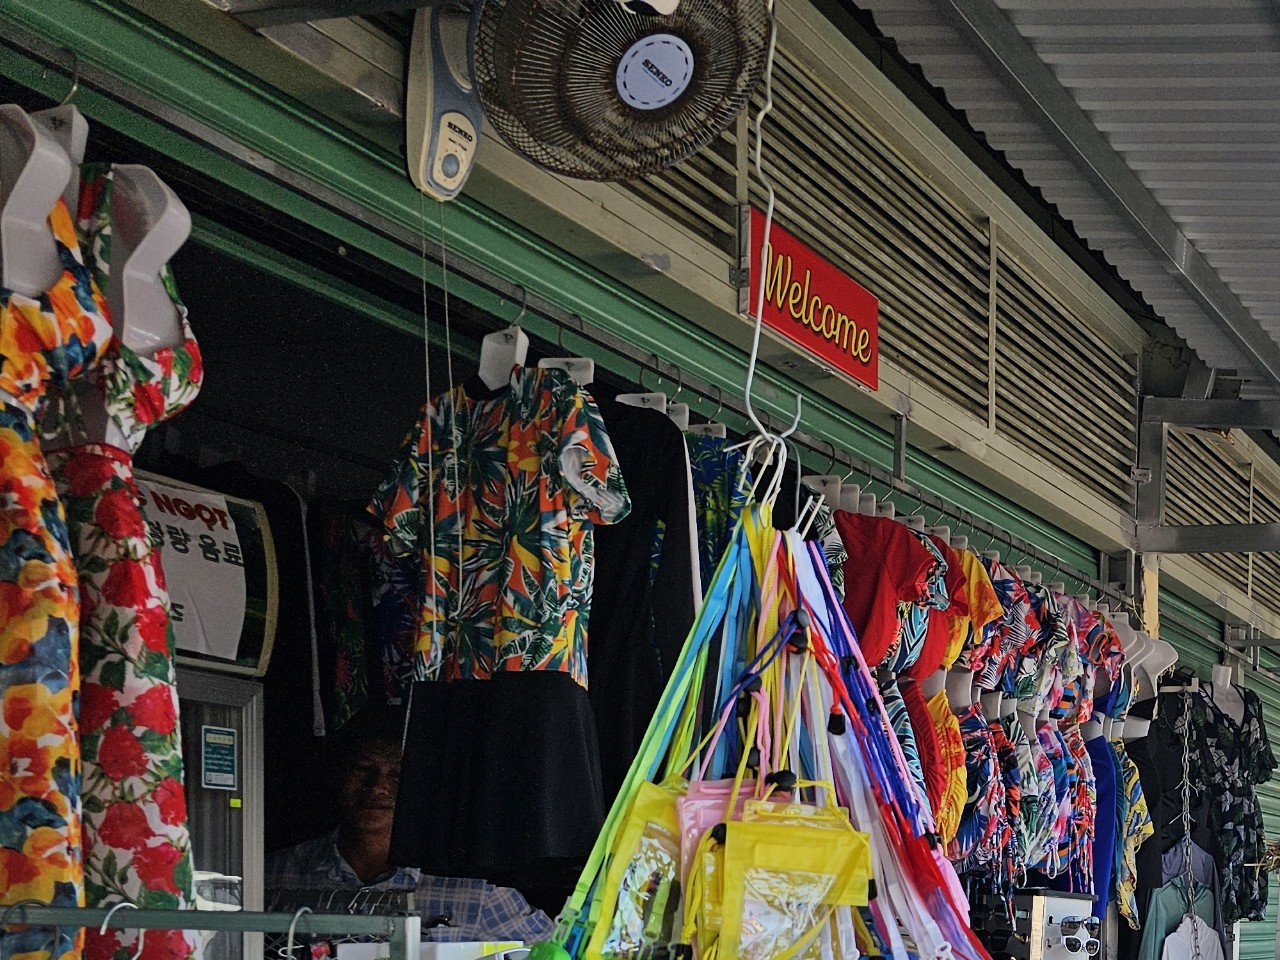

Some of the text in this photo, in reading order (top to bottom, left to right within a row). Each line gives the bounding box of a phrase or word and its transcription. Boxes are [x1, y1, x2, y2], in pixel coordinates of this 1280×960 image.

[642, 59, 672, 87] SENKO
[447, 121, 473, 142] SENKO
[761, 242, 872, 363] Welcome
[150, 491, 229, 531] NGỌT
